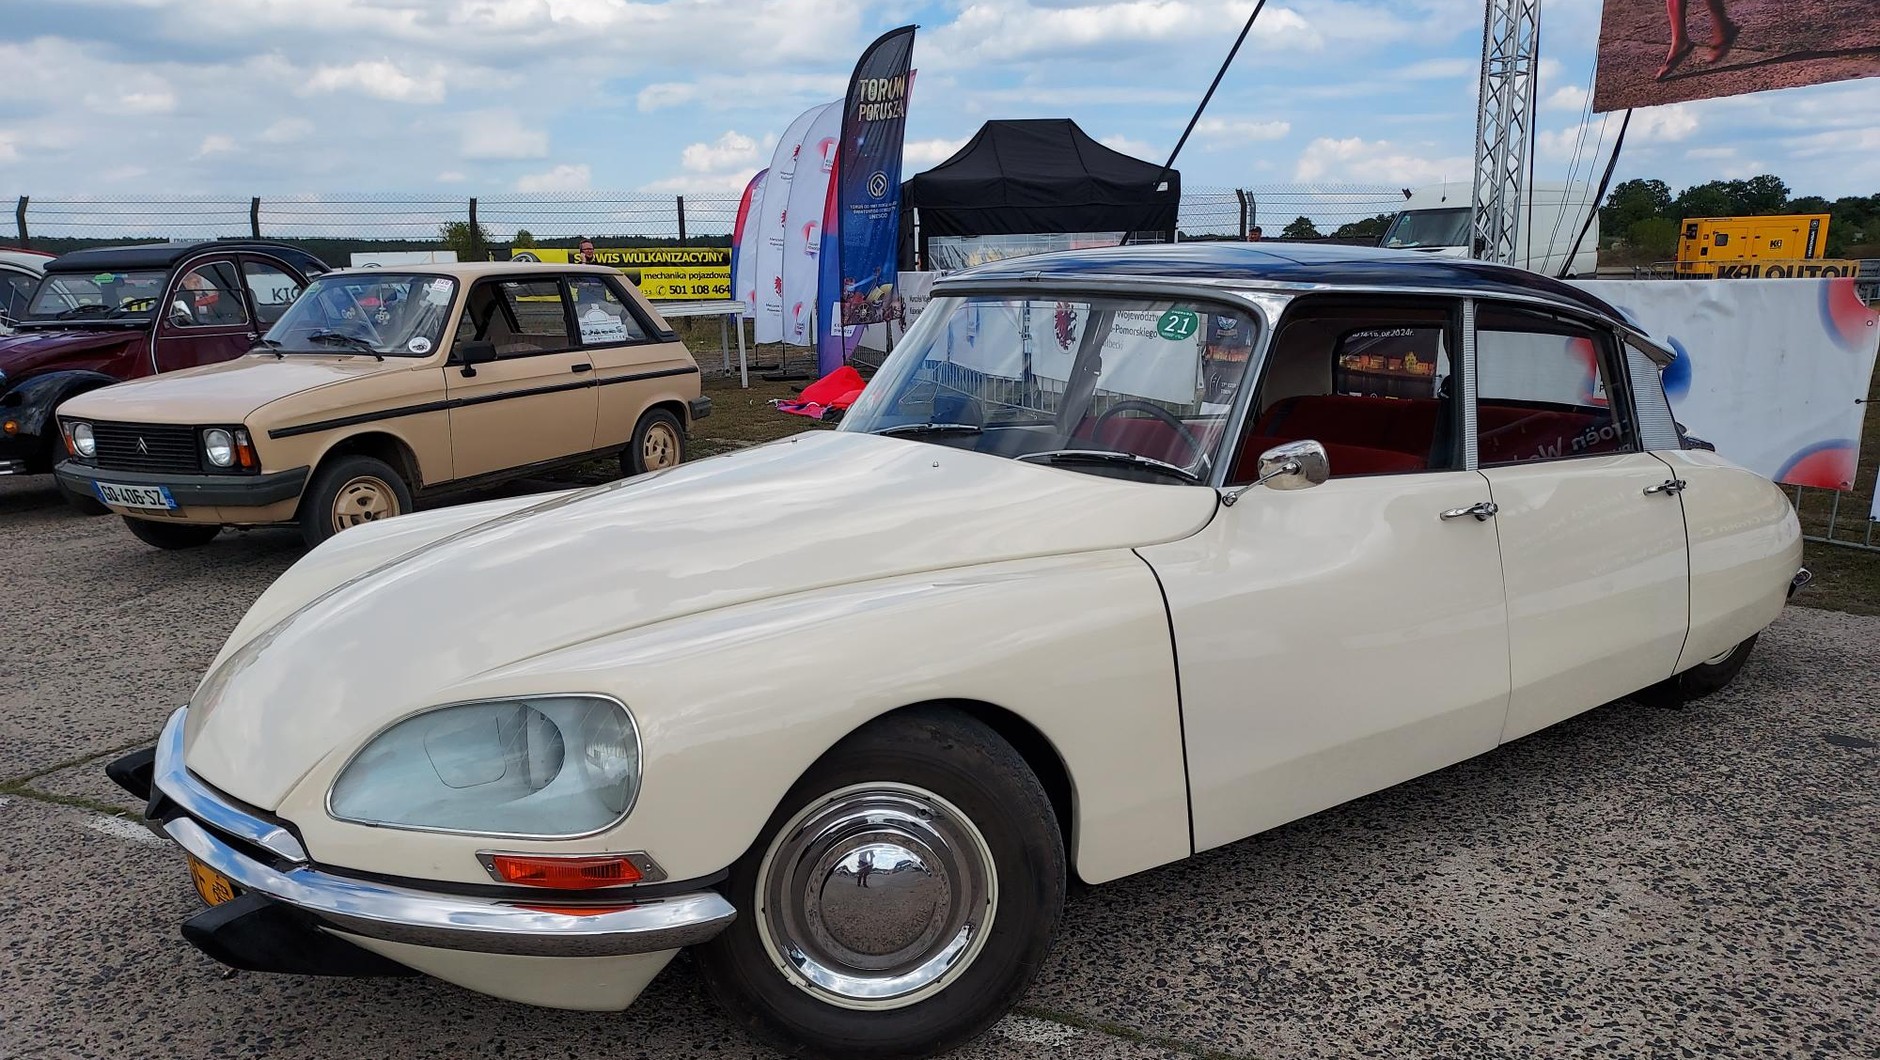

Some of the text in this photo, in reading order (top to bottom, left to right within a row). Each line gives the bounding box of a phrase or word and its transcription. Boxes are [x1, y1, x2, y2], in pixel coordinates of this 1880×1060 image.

[858, 100, 905, 121] PORUSZA
[574, 252, 724, 263] SWIS WULKANIZACYJNY
[644, 271, 730, 281] mechanika pojazdowa
[669, 285, 688, 295] 501
[691, 285, 709, 295] 108
[712, 284, 731, 295] 464
[1164, 315, 1190, 334] 21
